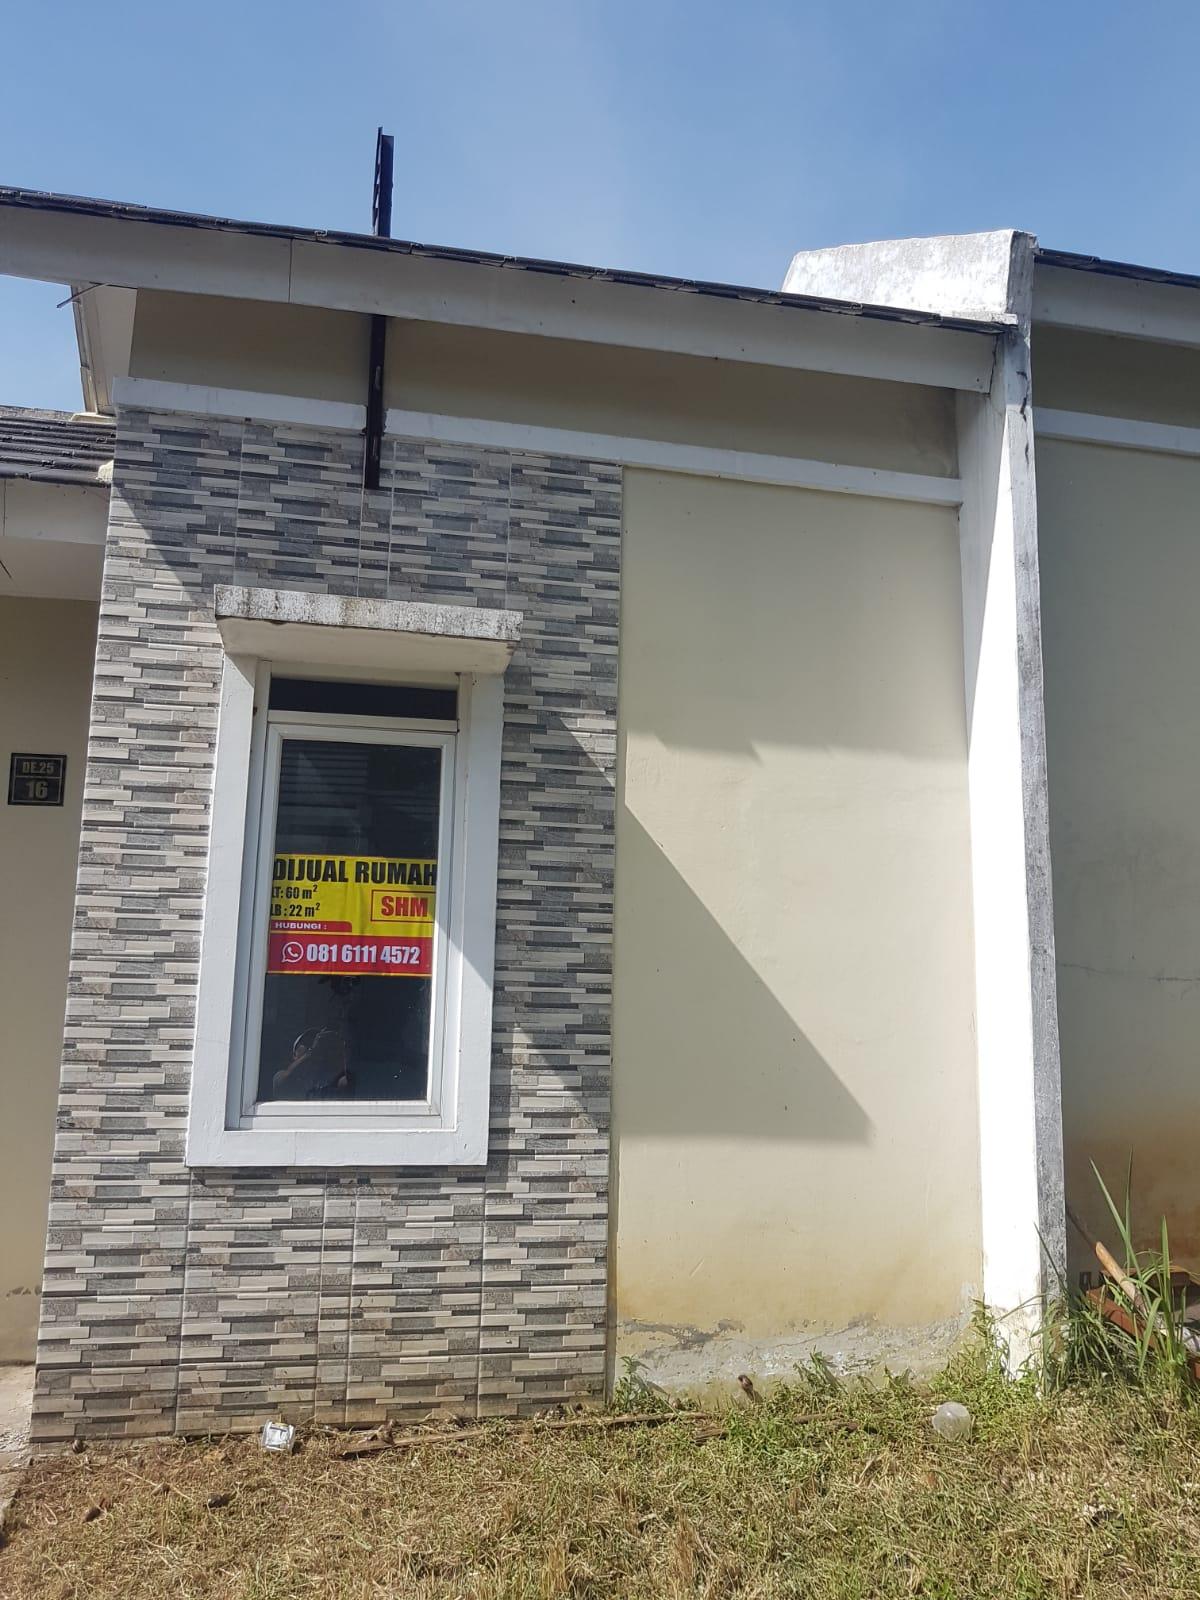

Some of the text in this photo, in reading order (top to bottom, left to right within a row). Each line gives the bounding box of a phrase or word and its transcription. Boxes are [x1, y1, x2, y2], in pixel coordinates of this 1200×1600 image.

[25, 780, 48, 799] 16
[273, 858, 437, 885] DIJUAL RUMAH
[286, 886, 299, 899] 60
[289, 904, 302, 917] 22
[381, 895, 428, 917] SHM
[275, 922, 321, 930] HUBUNGI
[306, 944, 420, 965] 081 6111 4572
